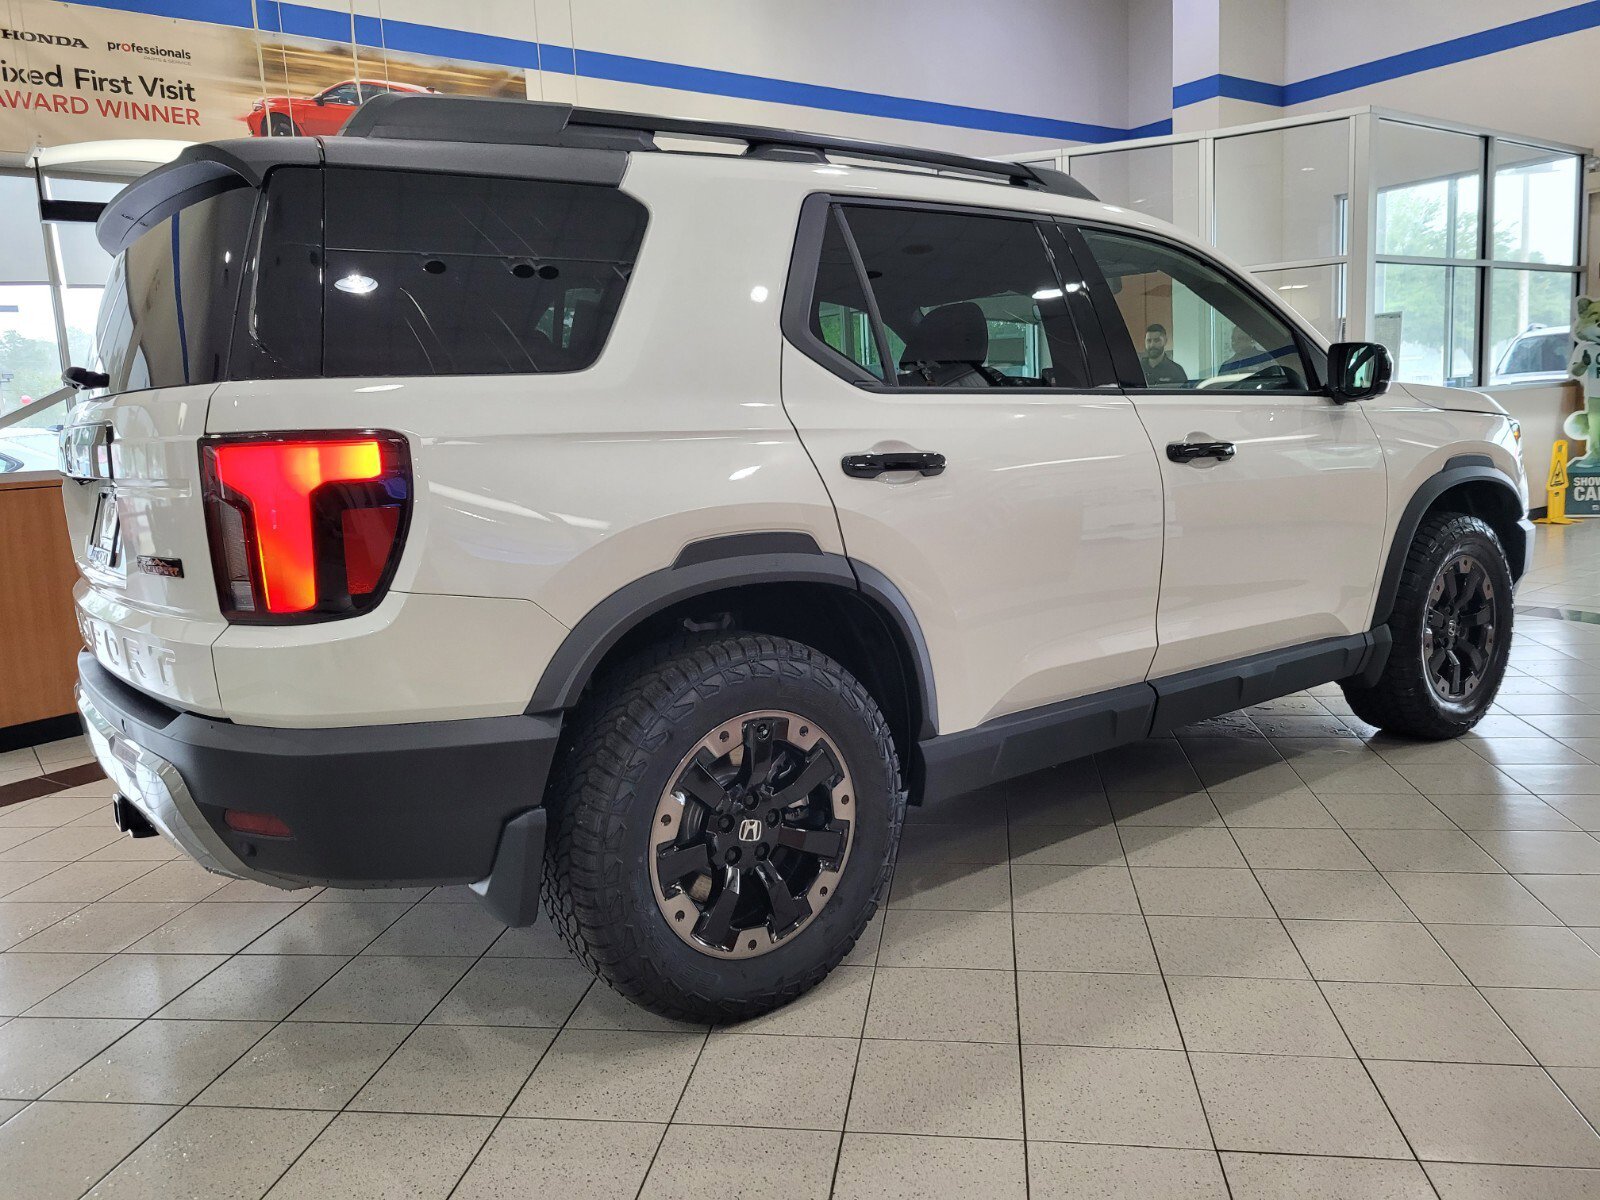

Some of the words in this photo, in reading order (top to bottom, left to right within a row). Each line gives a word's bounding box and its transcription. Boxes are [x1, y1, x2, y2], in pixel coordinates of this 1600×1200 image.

[0, 29, 89, 49] HONDA
[107, 42, 191, 60] professionals
[74, 68, 133, 95] First
[138, 75, 196, 102] Visit
[96, 98, 200, 126] WINNER
[1573, 486, 1600, 501] CA
